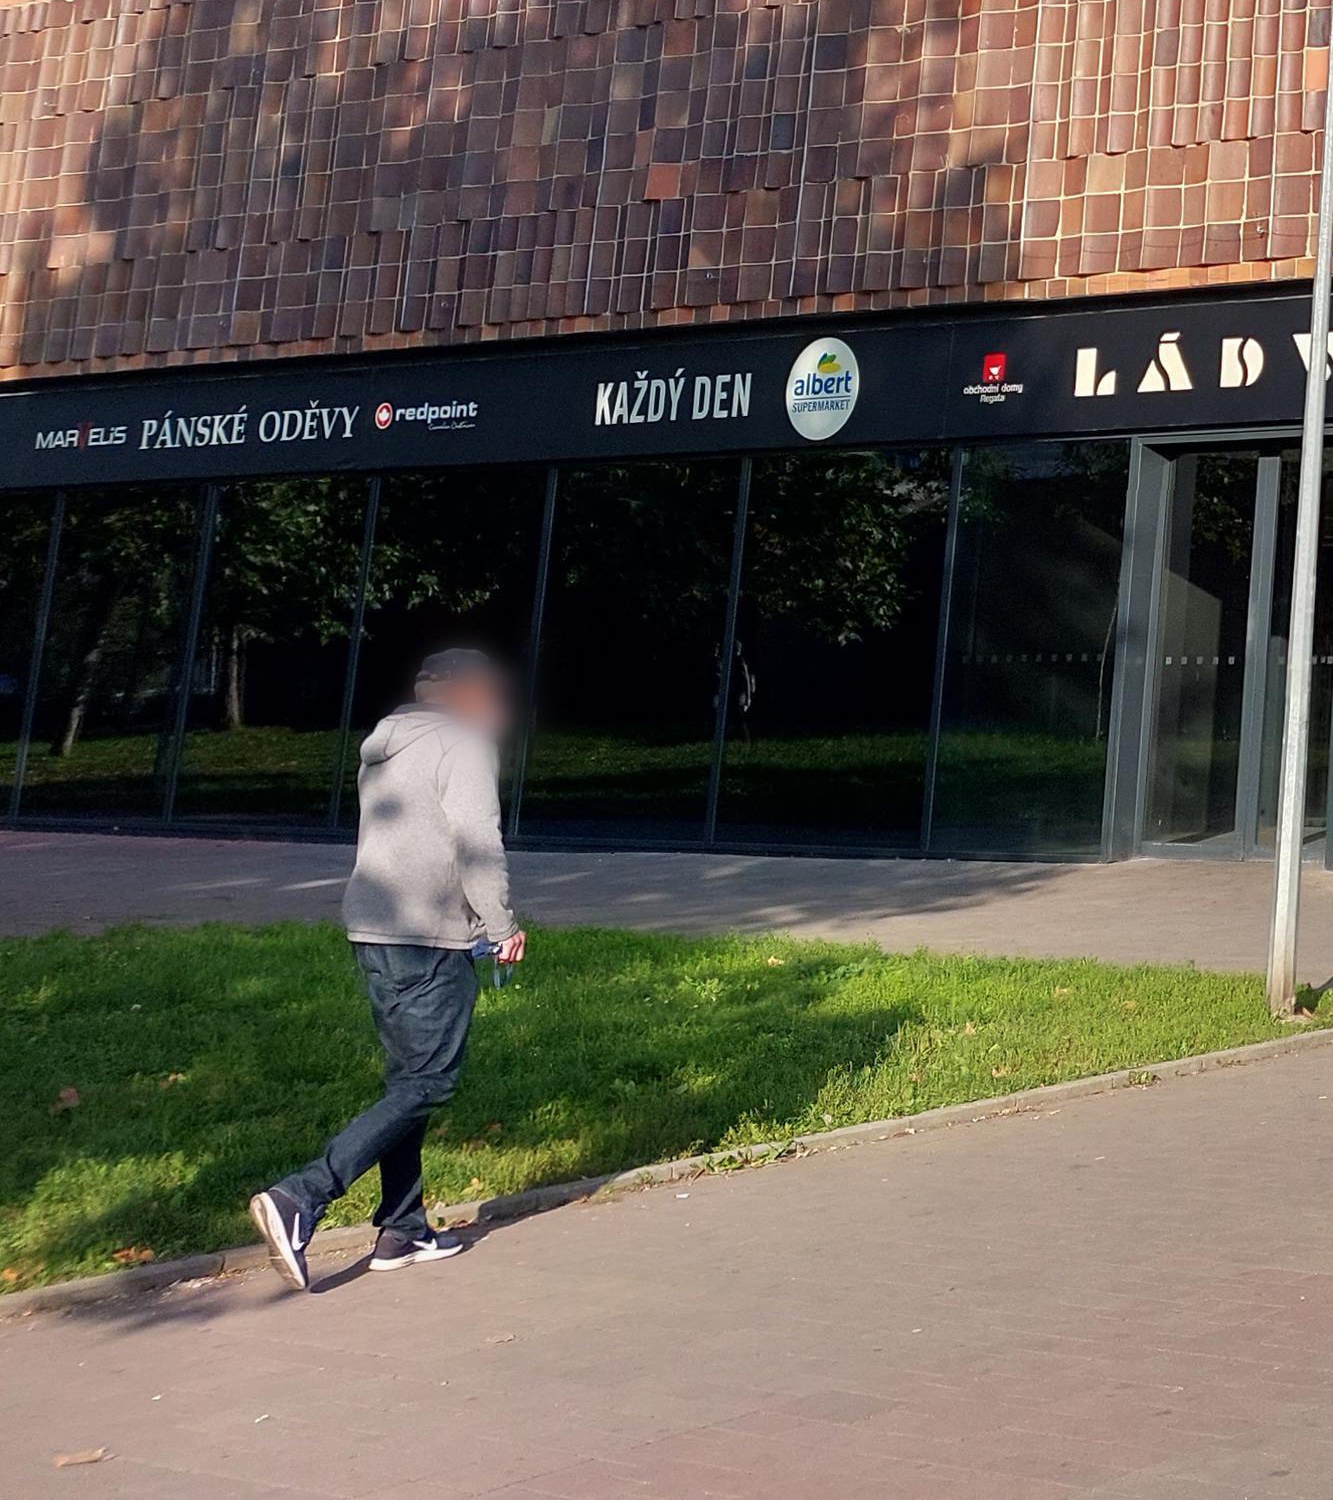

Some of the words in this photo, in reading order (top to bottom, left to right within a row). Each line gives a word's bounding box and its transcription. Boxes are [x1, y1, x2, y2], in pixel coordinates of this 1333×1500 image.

[794, 371, 853, 396] albert
[1001, 383, 1024, 393] domy
[594, 367, 687, 426] KAŽDÝ
[692, 373, 752, 420] DEN
[792, 400, 851, 413] SUPERMARKET
[395, 400, 479, 424] redpoint
[139, 404, 247, 450] PÁNSKÉ
[259, 400, 360, 443] ODĚVY
